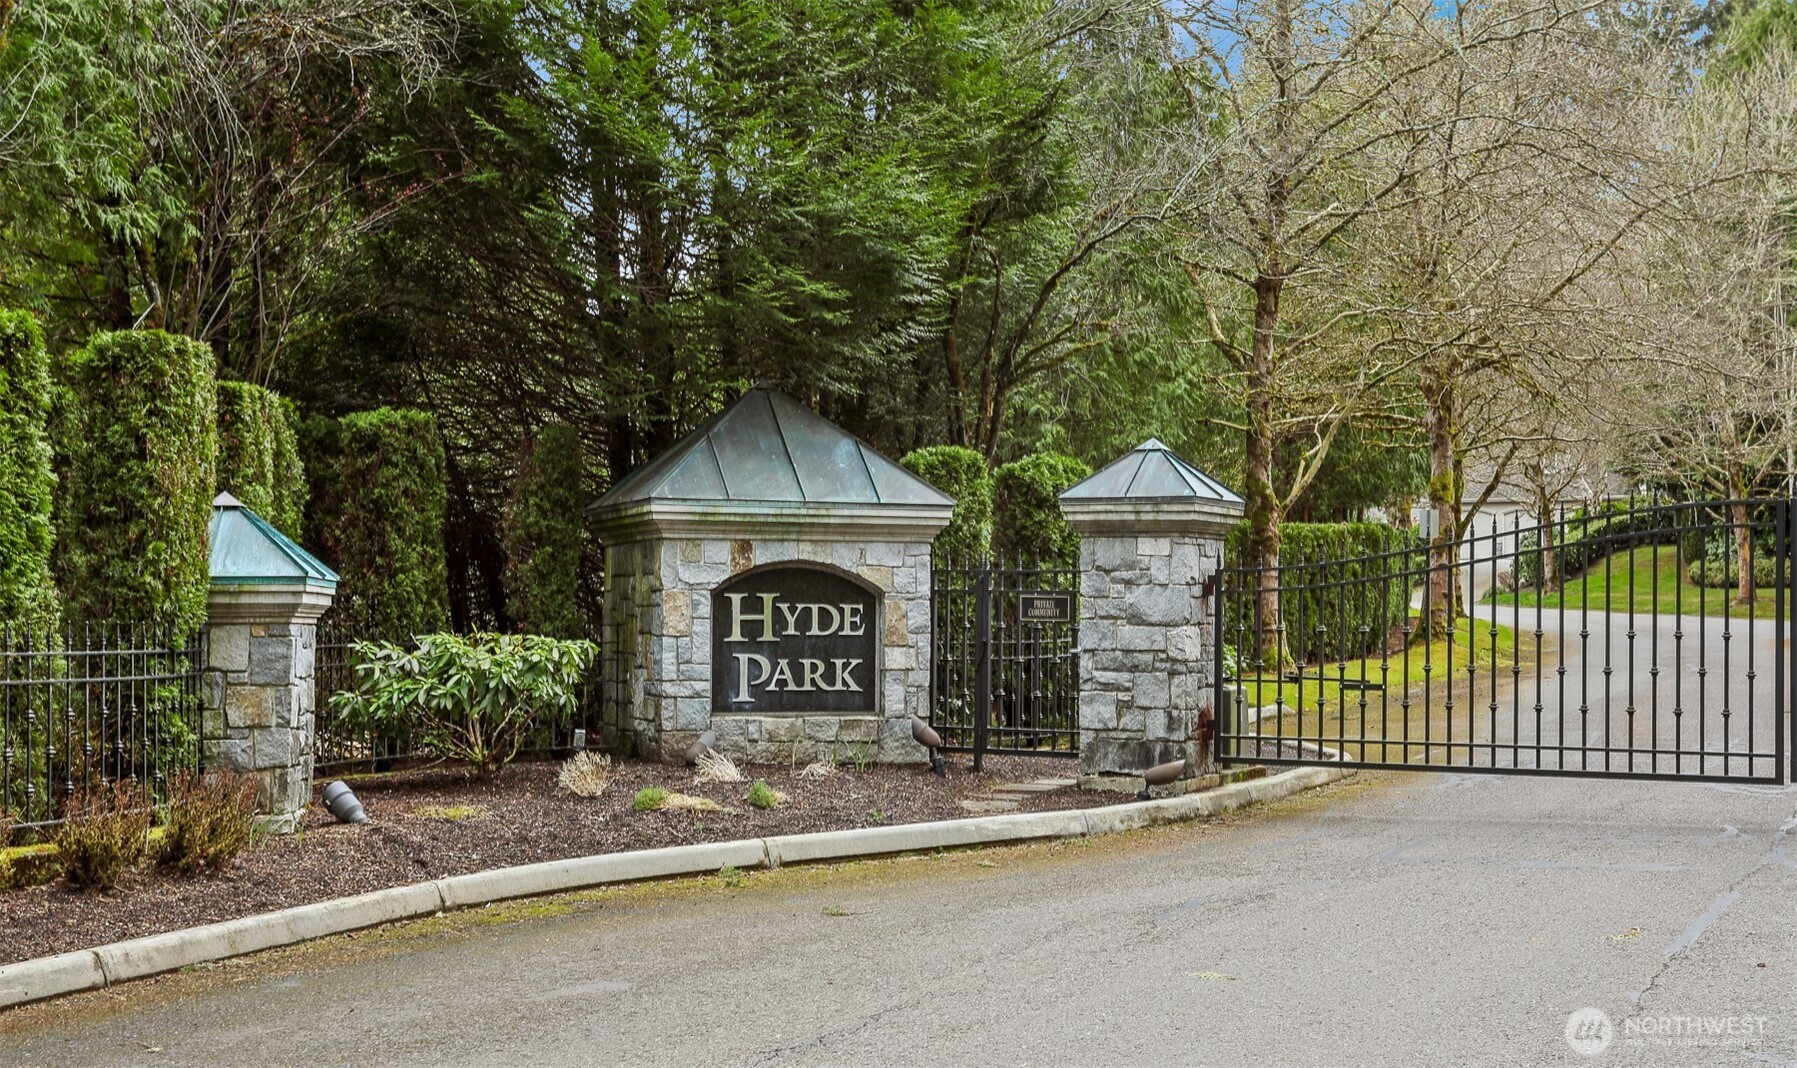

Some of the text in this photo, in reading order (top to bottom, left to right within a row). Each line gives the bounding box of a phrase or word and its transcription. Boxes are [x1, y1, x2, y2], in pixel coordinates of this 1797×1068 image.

[724, 592, 866, 642] HYDE
[1027, 608, 1060, 617] COMMUNITY
[1033, 599, 1055, 608] PRIVATE
[732, 652, 864, 703] PARK
